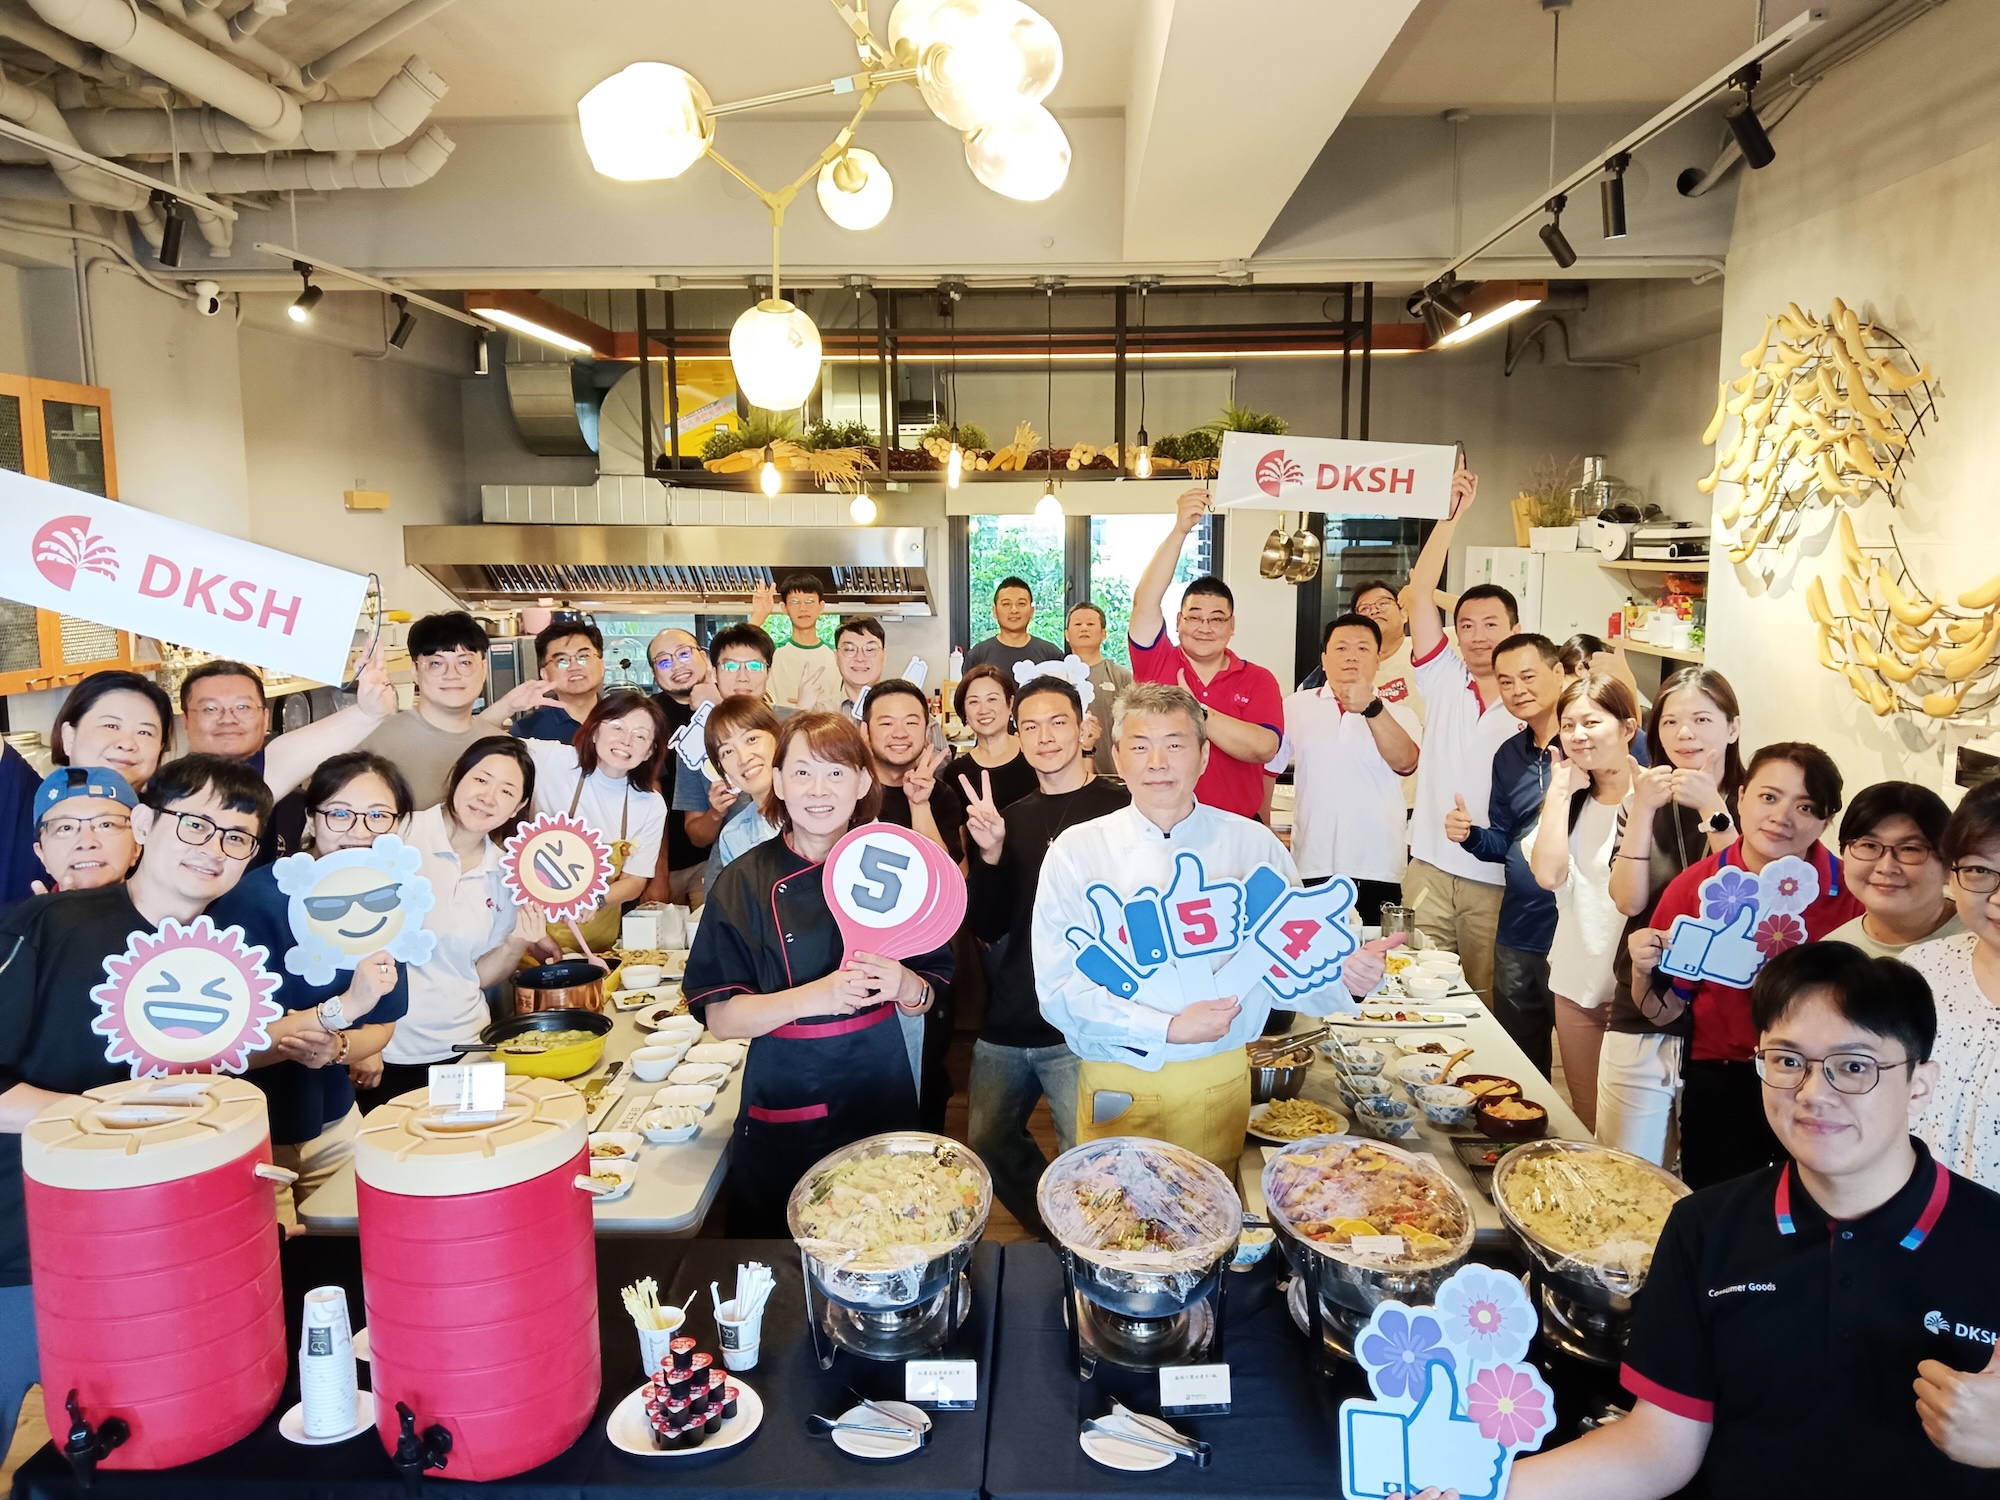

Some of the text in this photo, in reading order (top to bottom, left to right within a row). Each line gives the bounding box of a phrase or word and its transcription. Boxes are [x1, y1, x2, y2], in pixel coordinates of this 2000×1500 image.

[1317, 463, 1414, 494] DKSH
[139, 554, 302, 635] DKSH
[851, 844, 911, 914] 5
[1177, 898, 1218, 946] 5
[1280, 919, 1321, 960] 4
[1708, 1282, 1776, 1297] Consumer Goods
